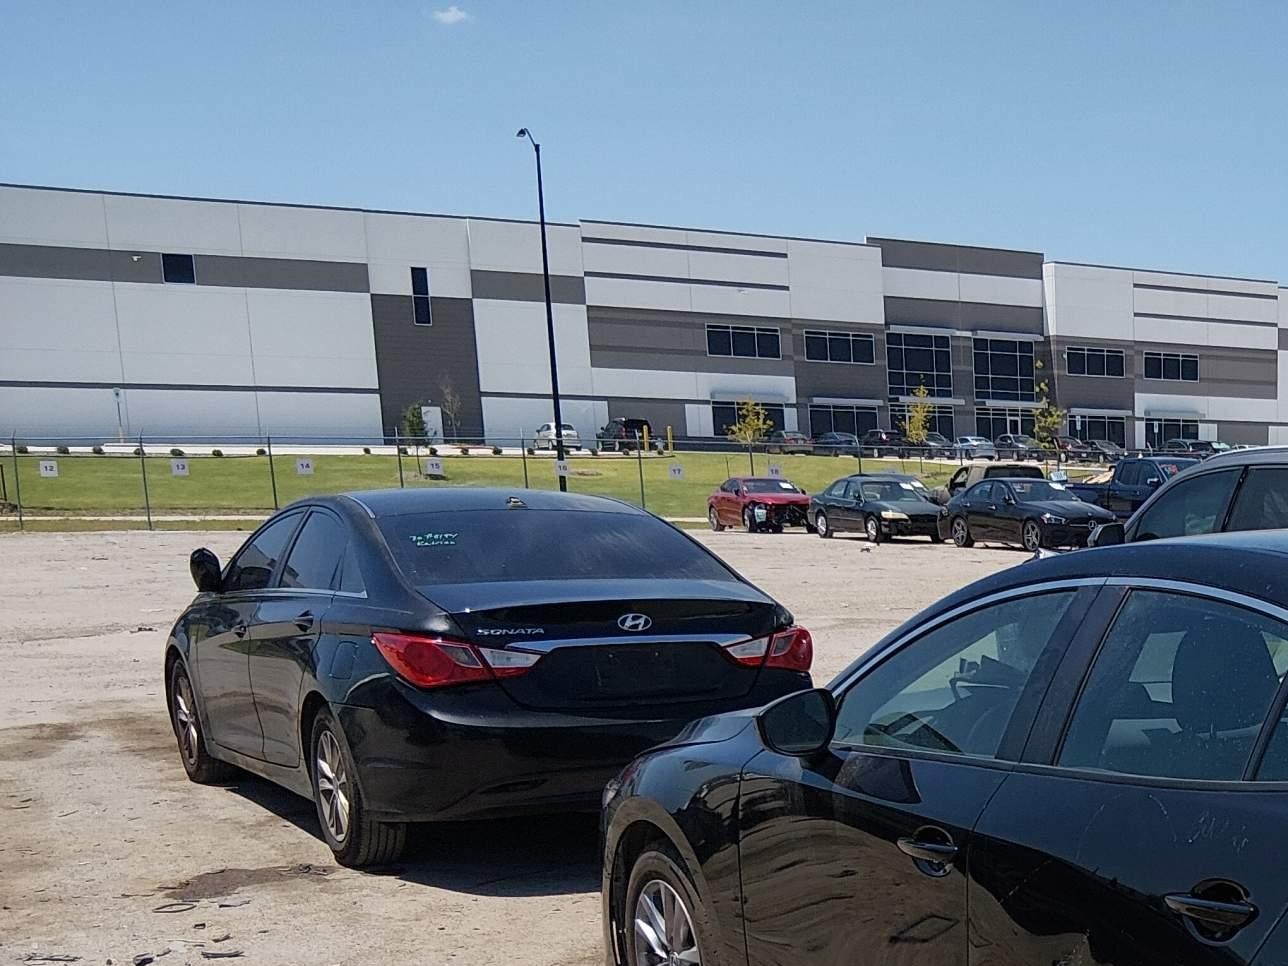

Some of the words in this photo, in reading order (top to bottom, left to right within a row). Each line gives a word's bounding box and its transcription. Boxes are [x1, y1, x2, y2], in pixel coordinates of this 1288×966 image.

[43, 465, 55, 473] 12
[175, 463, 187, 471] 13
[299, 462, 311, 470] 14
[429, 462, 441, 470] 15
[557, 464, 568, 472] 16
[475, 627, 545, 636] SONATA
